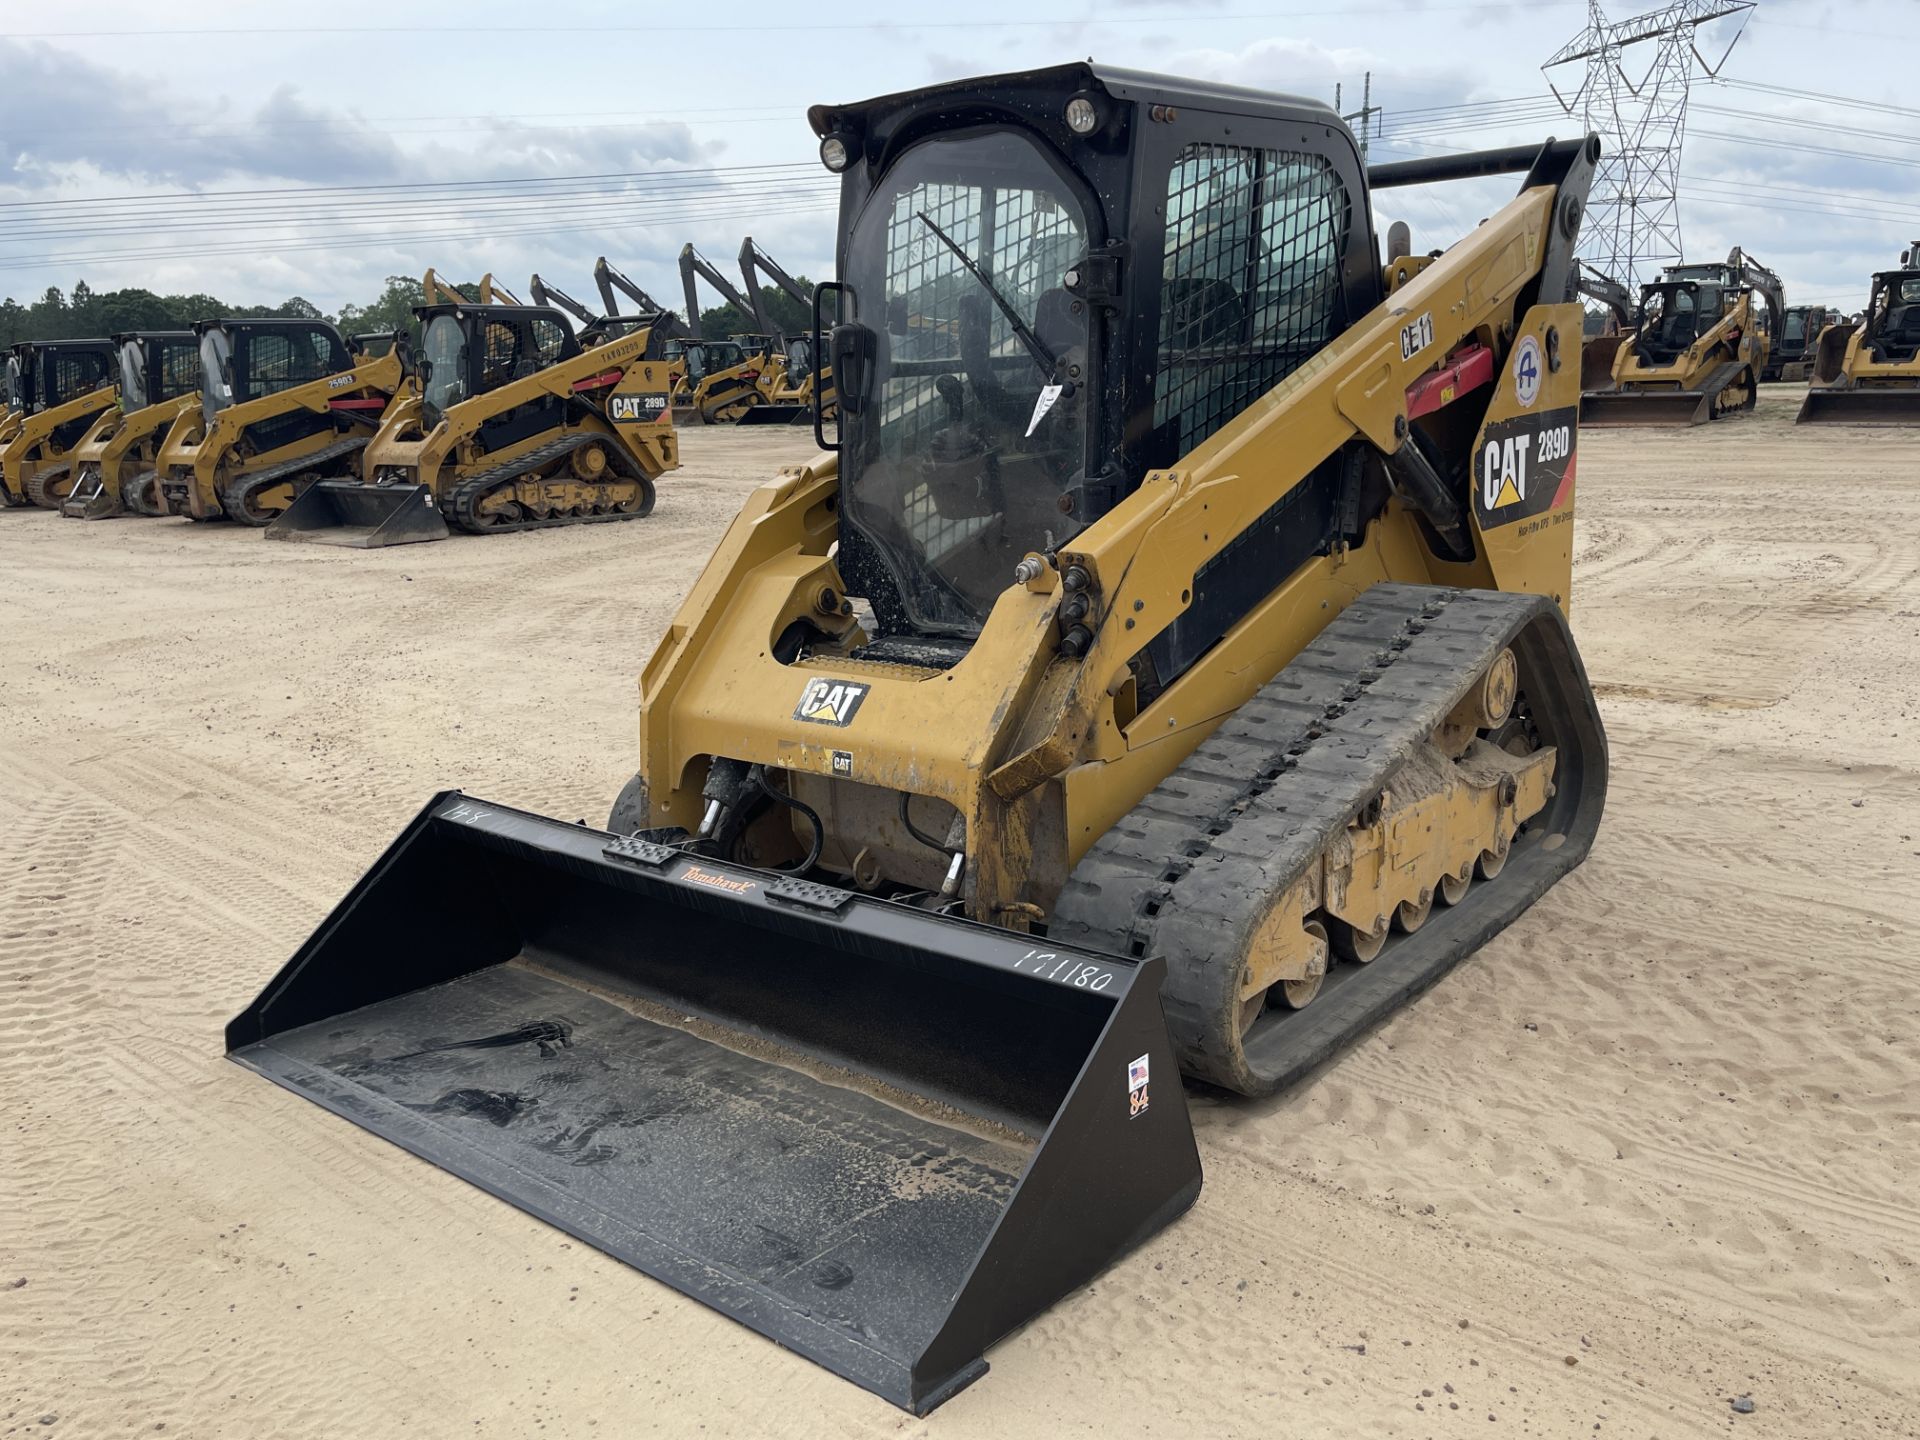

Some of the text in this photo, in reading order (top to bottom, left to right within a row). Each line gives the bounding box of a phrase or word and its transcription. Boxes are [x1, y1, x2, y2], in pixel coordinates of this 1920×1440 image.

[328, 375, 353, 389] 259D3
[612, 397, 665, 419] CAT 289D
[1484, 426, 1570, 511] CAT 289D
[801, 682, 863, 722] CAT
[834, 756, 851, 771] CAT
[680, 866, 756, 893] Tomahawk
[1013, 950, 1113, 991] 171180
[1130, 1084, 1149, 1115] 84
